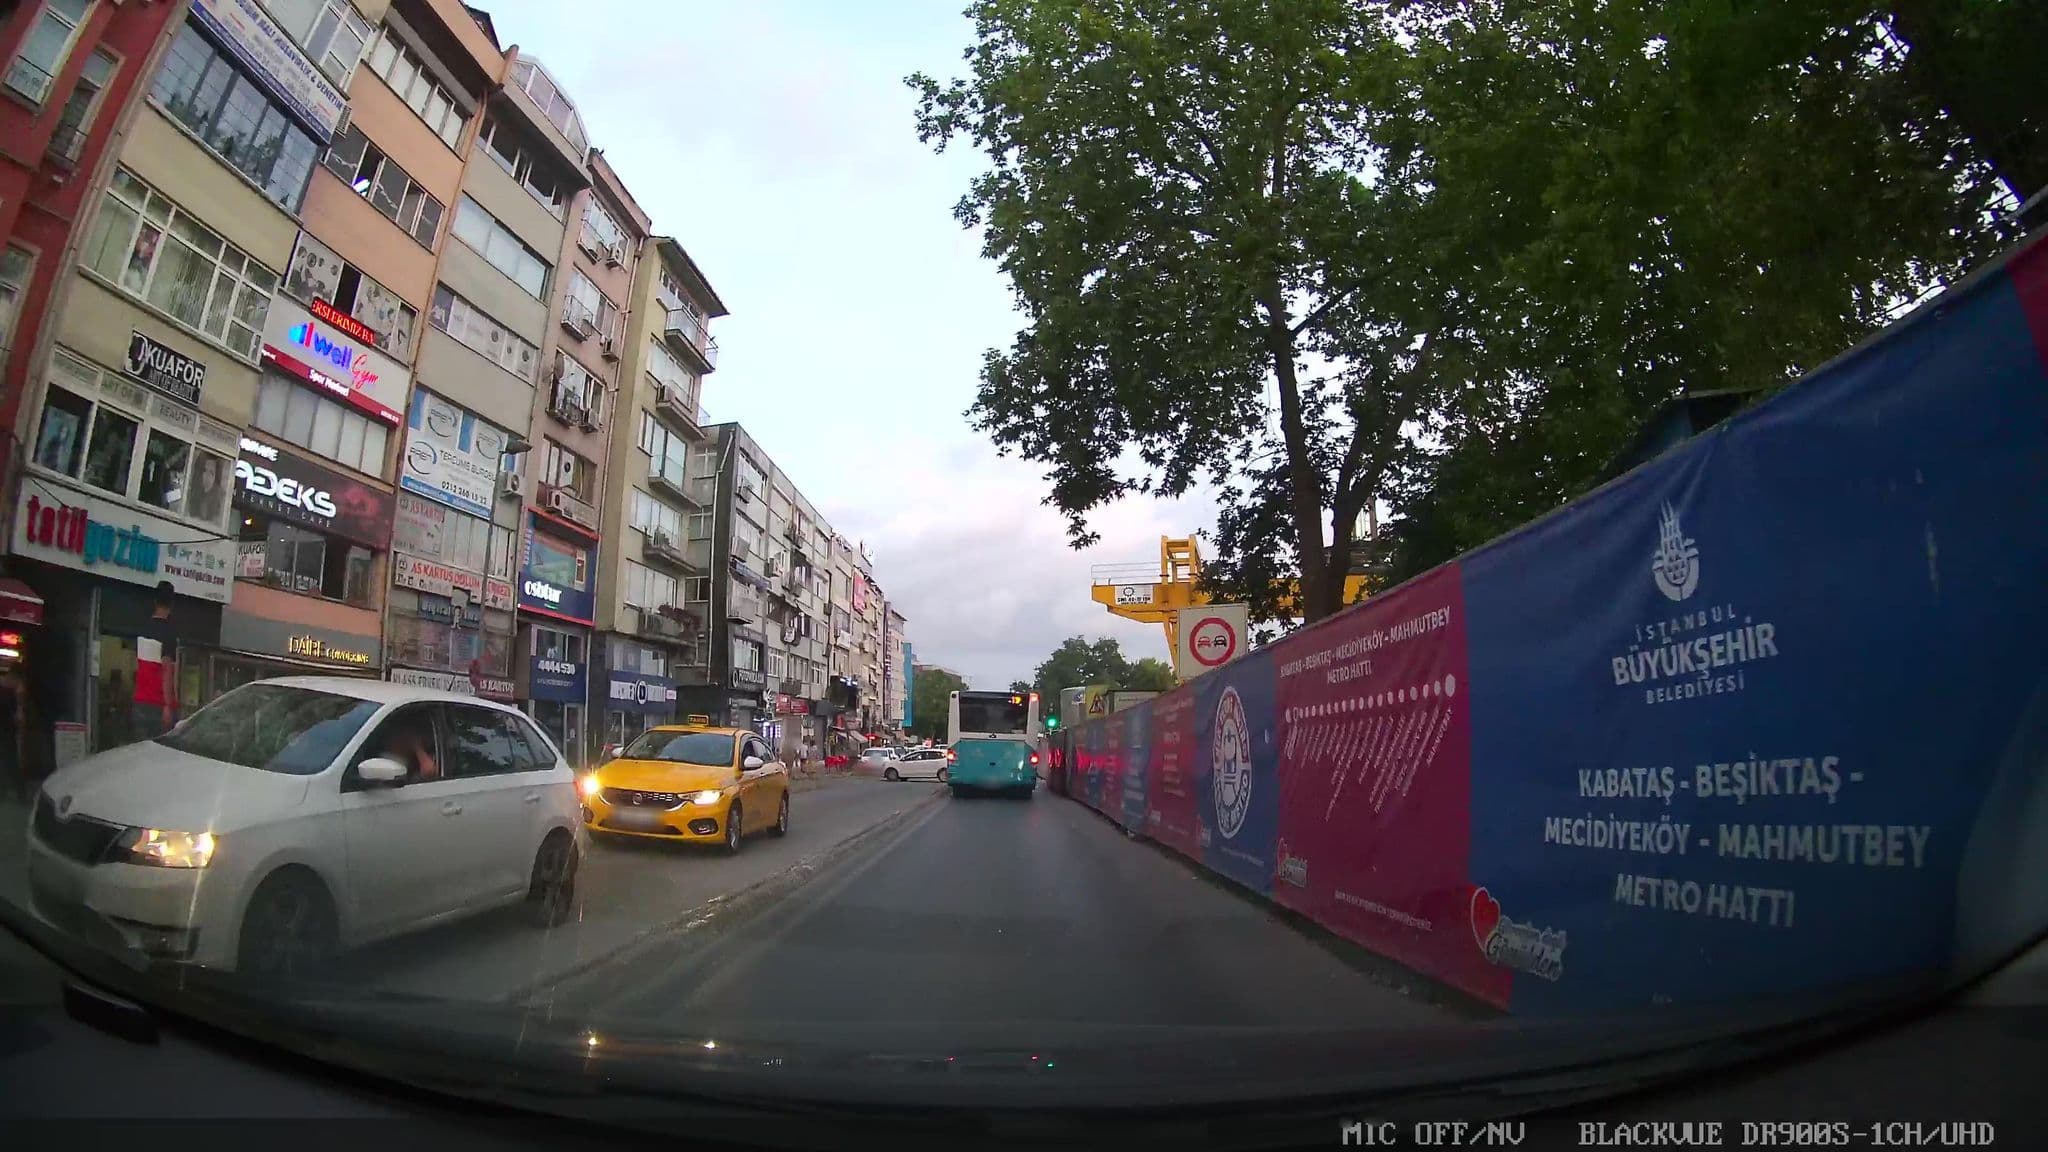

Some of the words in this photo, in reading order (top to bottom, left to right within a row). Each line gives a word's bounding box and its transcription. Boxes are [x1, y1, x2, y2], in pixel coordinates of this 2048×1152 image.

[147, 343, 204, 390] KUAFÖR
[314, 332, 352, 369] well
[352, 354, 379, 389] Gym
[441, 481, 457, 493] 0212
[411, 562, 423, 574] AS
[1390, 606, 1451, 644] MAHMUTBEY
[1635, 603, 1738, 643] İSTANBUL
[289, 634, 327, 658] DAİRE
[1612, 616, 1780, 686] BÜYÜKŞEHİR
[1327, 666, 1350, 685] METRO
[1350, 660, 1373, 681] HATTI
[1646, 669, 1745, 705] BELEDİYESİ
[1578, 767, 1675, 805] KABATAŞ
[1696, 751, 1841, 806] BEŞİKTAŞ
[1544, 812, 1692, 855] MECİDİYEKÖY
[1718, 824, 1932, 869] MAHMUTBEY
[1615, 873, 1701, 914] METRO
[1706, 884, 1796, 928] HATTI
